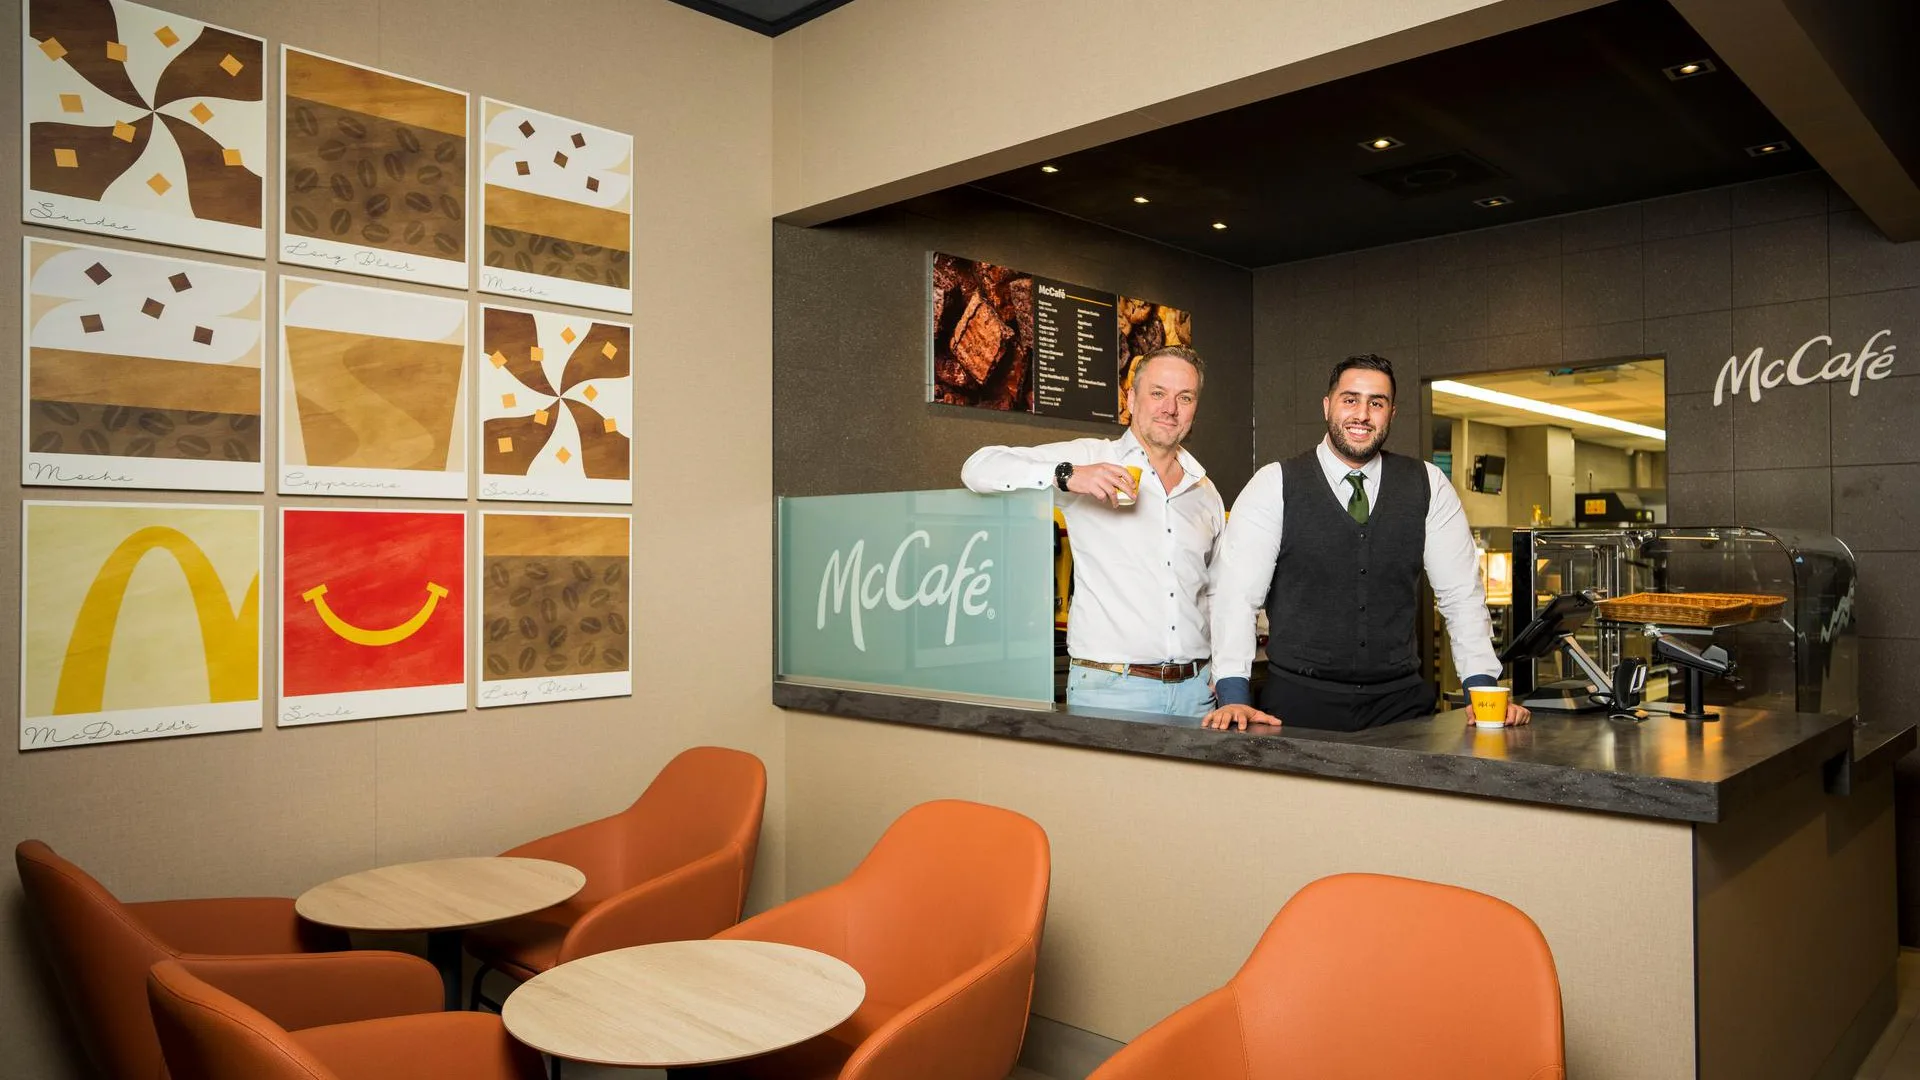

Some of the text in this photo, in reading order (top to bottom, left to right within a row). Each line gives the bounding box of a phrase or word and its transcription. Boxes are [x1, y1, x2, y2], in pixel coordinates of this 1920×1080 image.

[285, 242, 346, 265] Long
[1038, 284, 1066, 299] McCafé
[1713, 329, 1896, 407] McCafé
[29, 462, 134, 482] Mocha
[817, 530, 993, 652] McCafé
[24, 721, 198, 744] McDonald's
